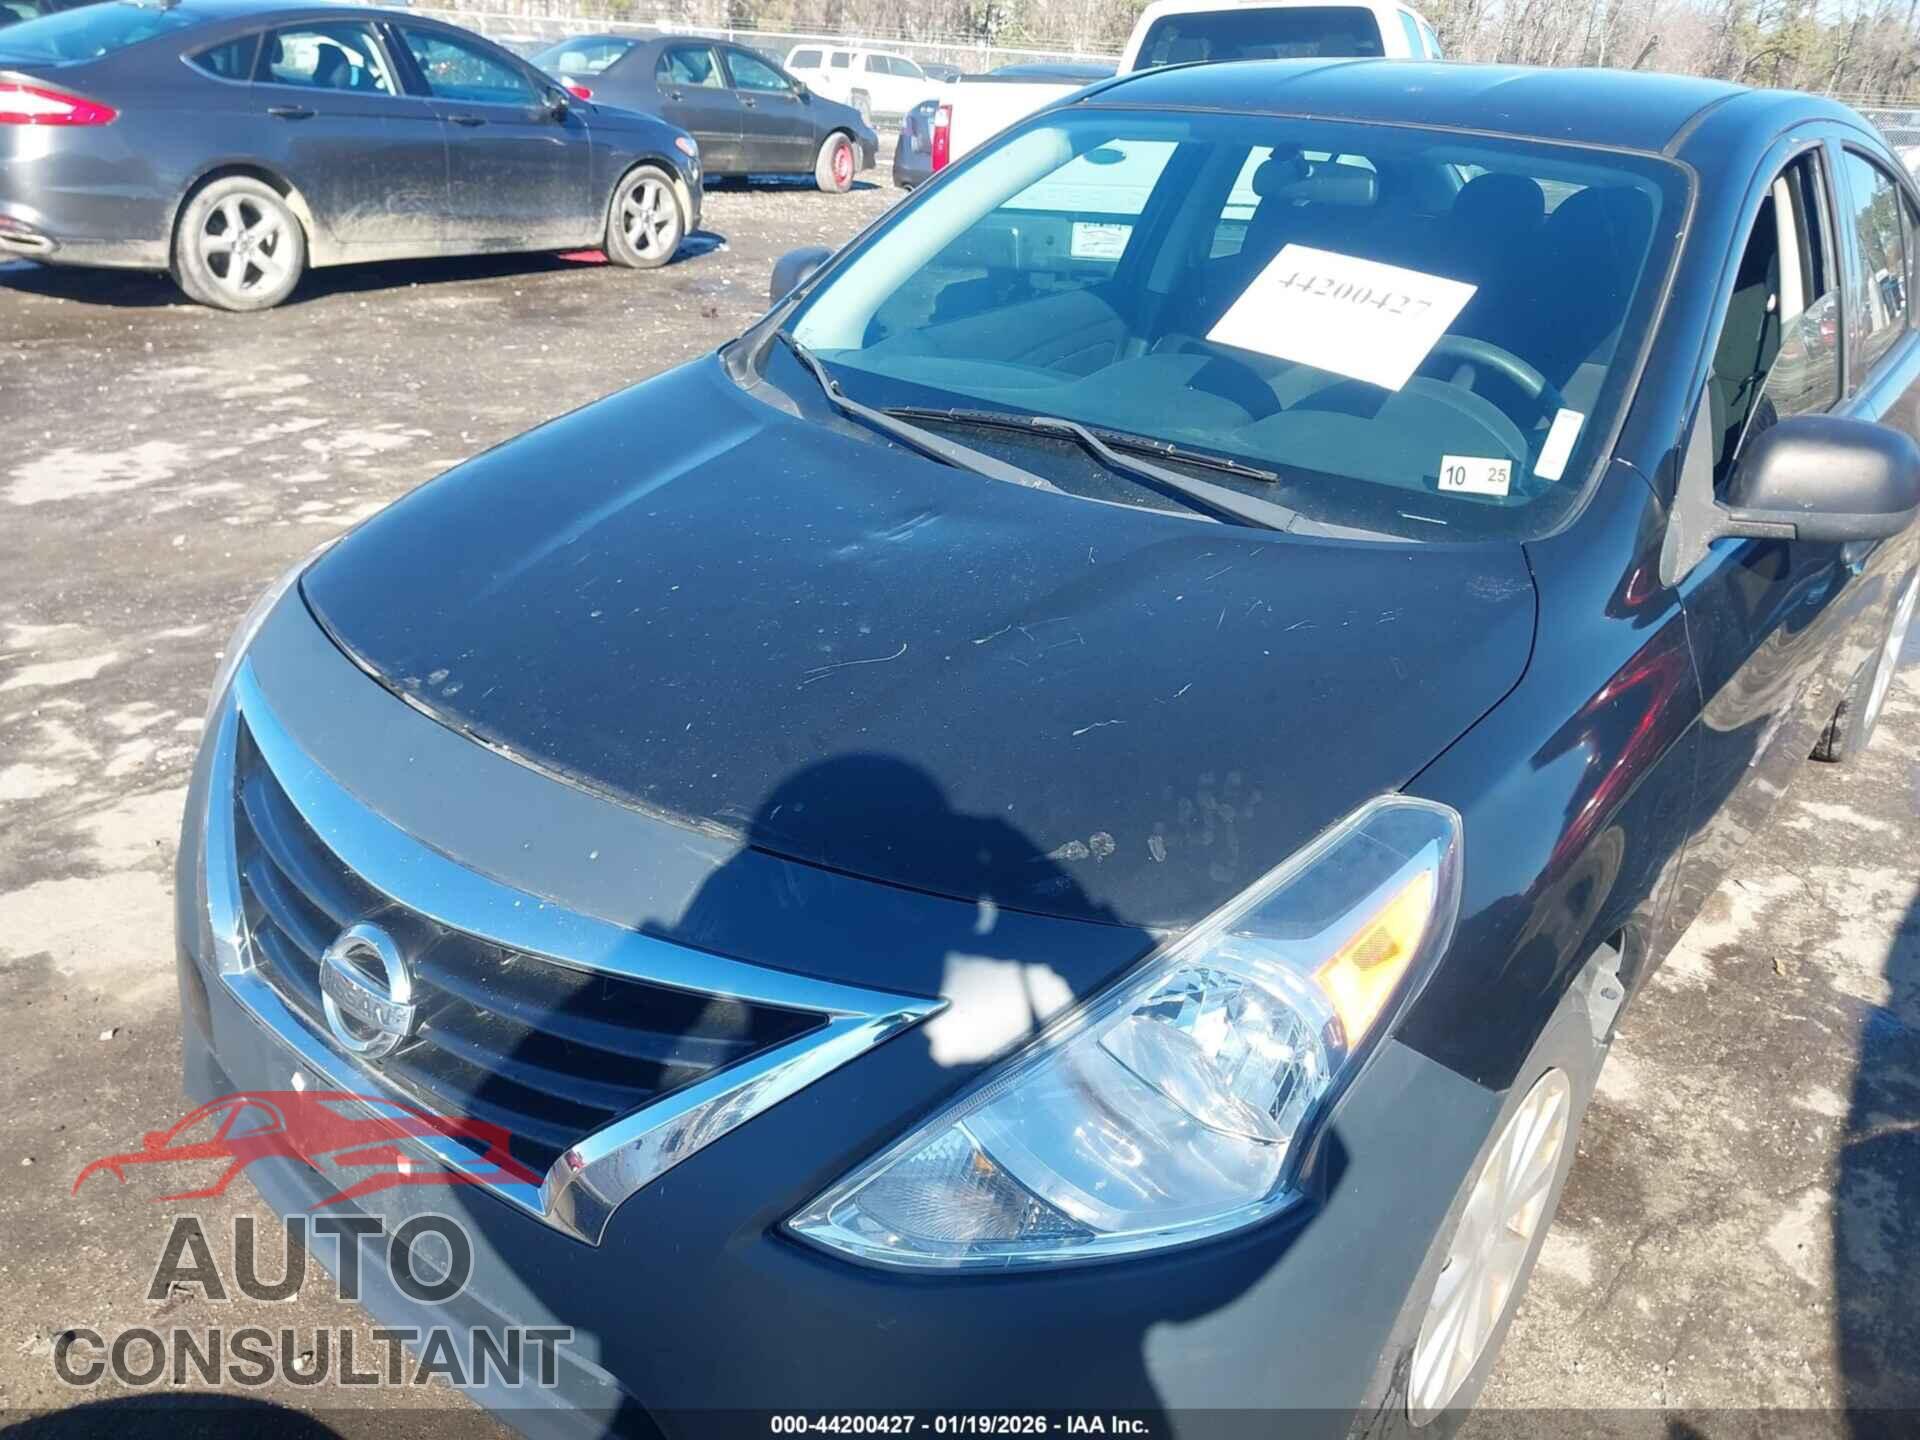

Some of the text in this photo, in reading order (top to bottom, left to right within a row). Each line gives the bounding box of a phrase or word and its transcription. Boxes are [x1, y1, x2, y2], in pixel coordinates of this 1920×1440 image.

[1277, 271, 1434, 318] 44200427
[1446, 465, 1507, 486] 10 25
